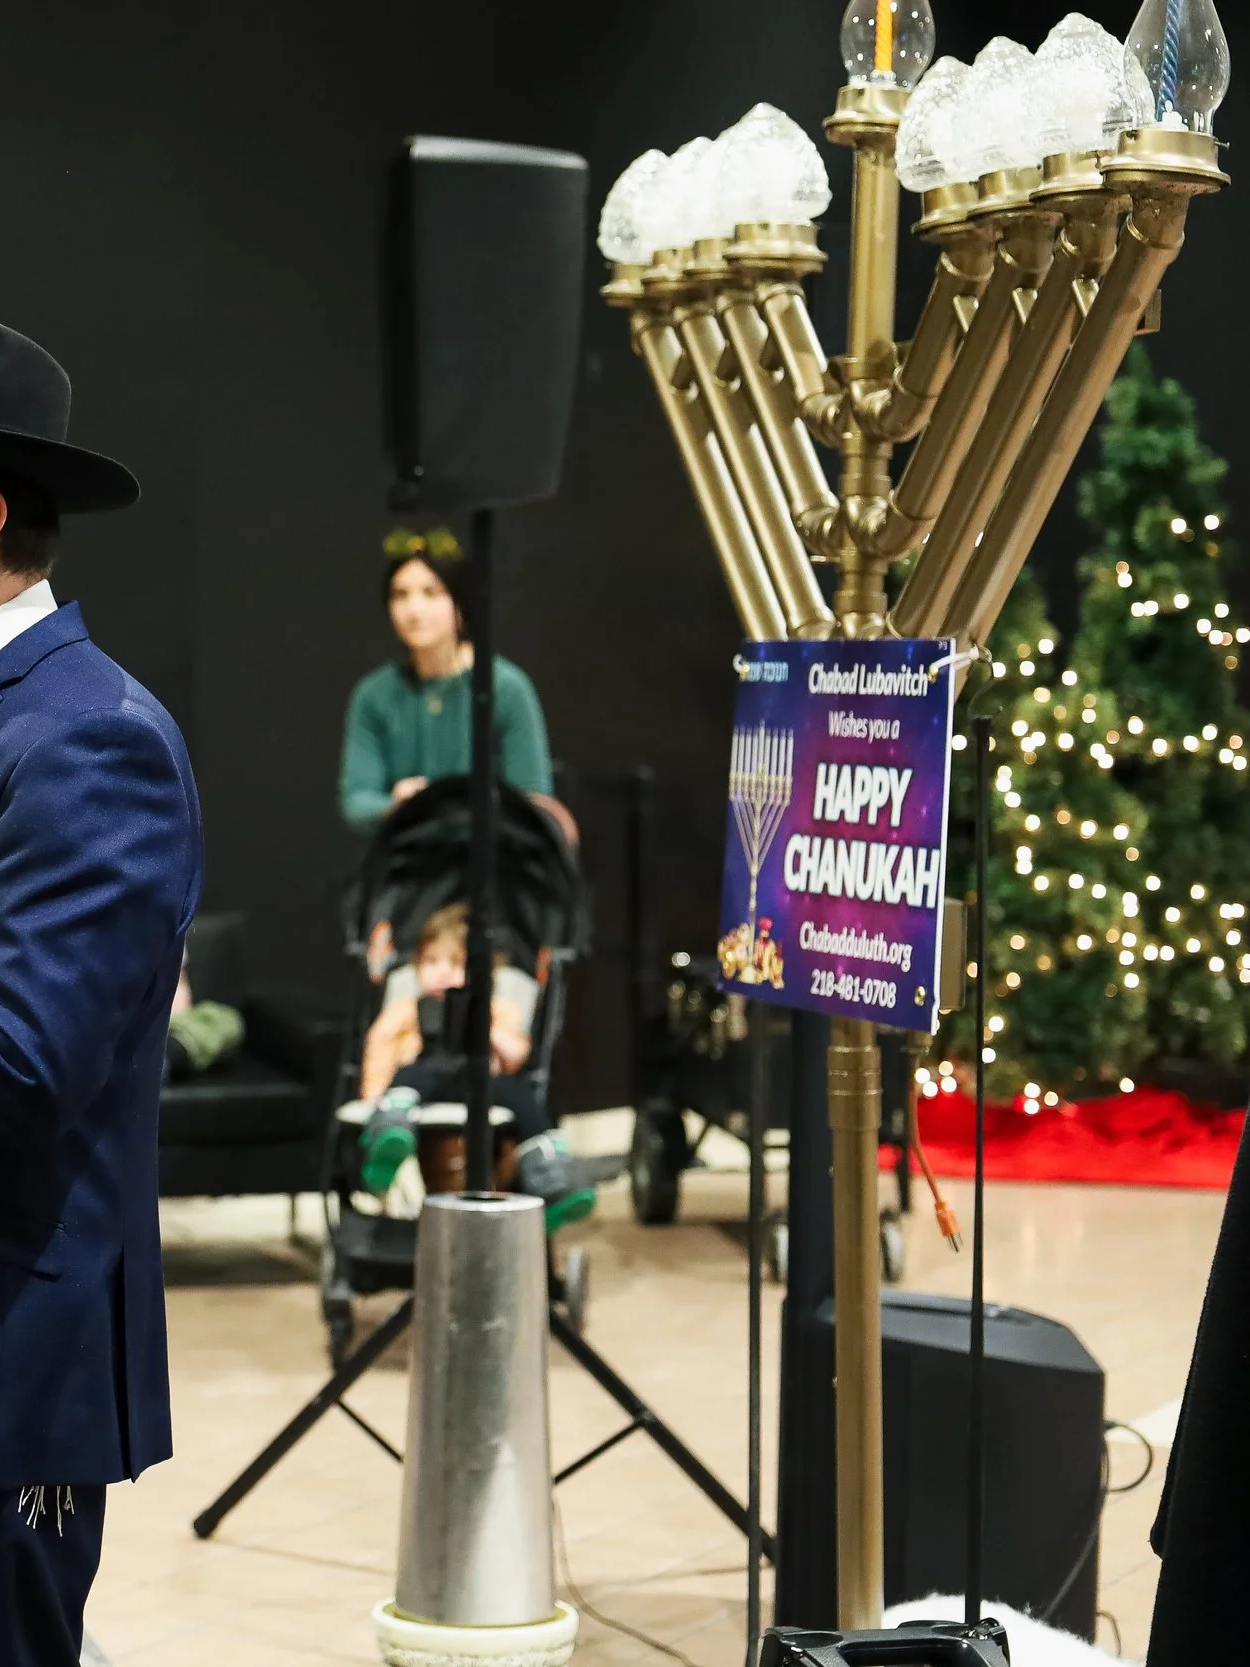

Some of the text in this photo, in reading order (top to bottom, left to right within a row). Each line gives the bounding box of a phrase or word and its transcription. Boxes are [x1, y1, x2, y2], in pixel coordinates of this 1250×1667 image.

[808, 662, 928, 697] Chabad Lubavitch
[828, 710, 901, 744] Wishes you a
[813, 762, 913, 828] HAPPY
[783, 833, 941, 909] CHANUKAH
[799, 920, 913, 973] Chabadduluth.org
[810, 968, 897, 1009] 218-481-0708
